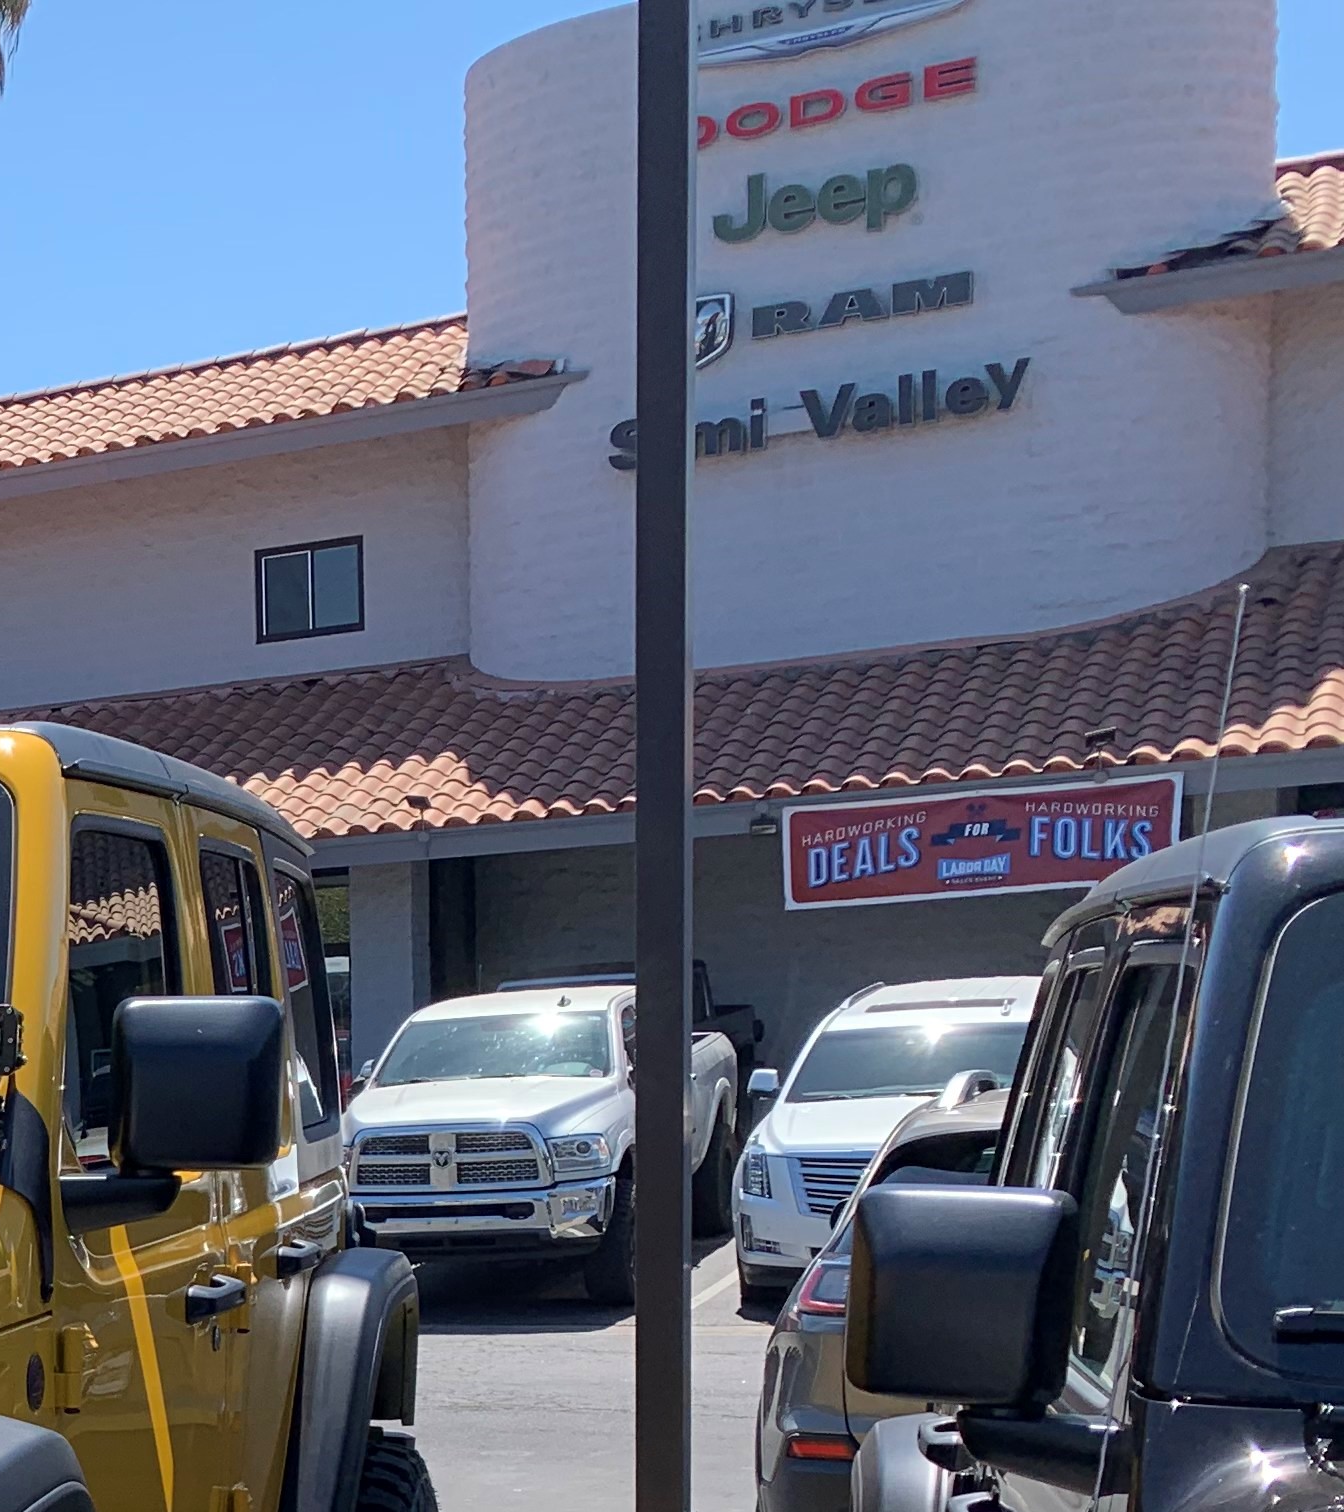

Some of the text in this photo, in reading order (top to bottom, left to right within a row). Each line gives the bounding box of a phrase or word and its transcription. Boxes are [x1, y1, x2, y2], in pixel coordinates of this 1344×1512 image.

[713, 163, 918, 244] Jeep
[752, 271, 974, 339] RAM
[609, 397, 768, 471] Smi
[801, 811, 928, 847] HARDWORKING
[963, 822, 990, 837] FOR
[1025, 801, 1160, 818] HARDWORKING
[807, 827, 921, 888] DEALS
[1029, 815, 1153, 860] FOLKS
[942, 856, 1007, 877] LABOR DAY
